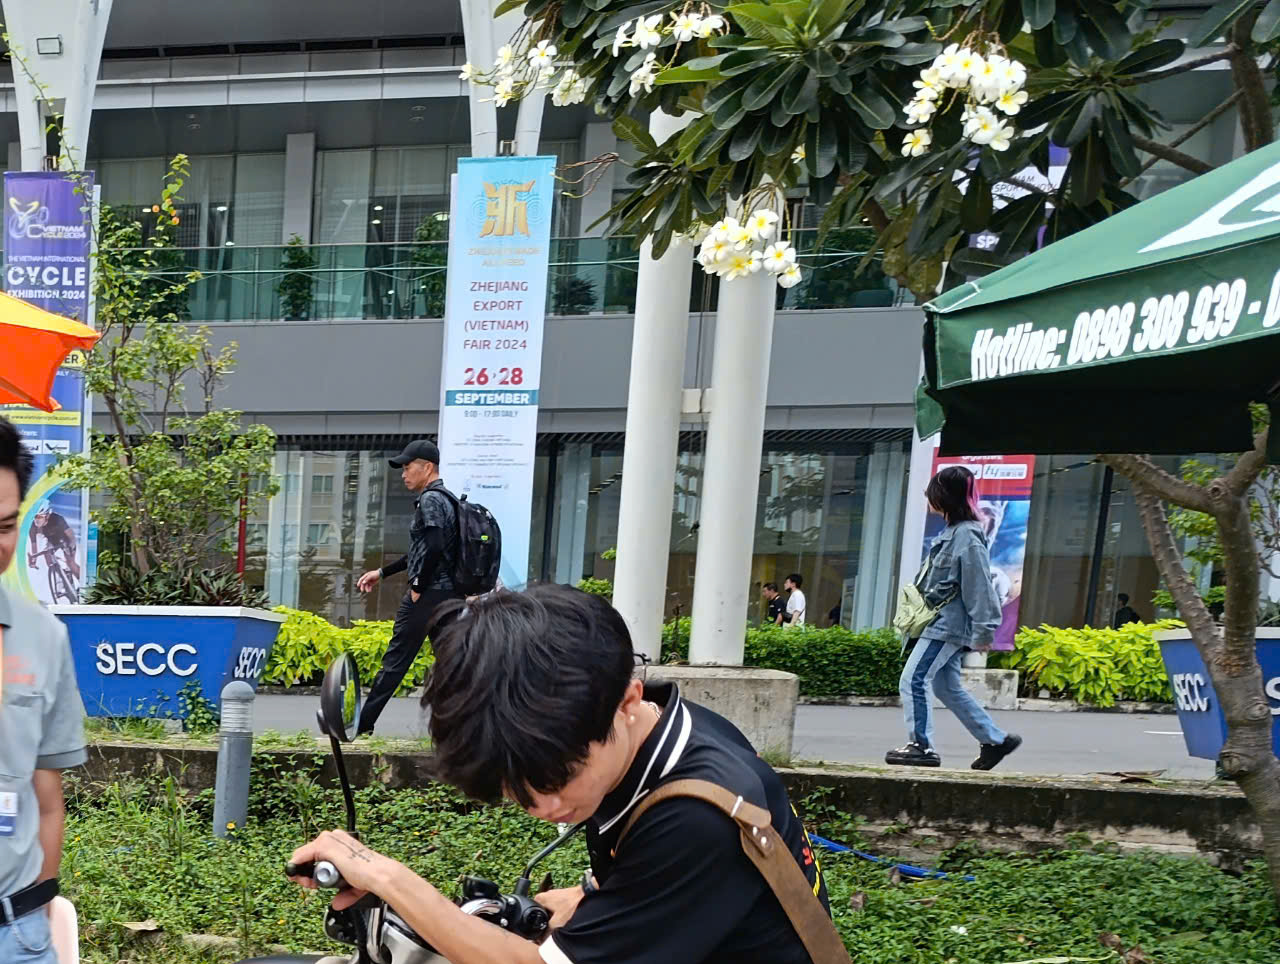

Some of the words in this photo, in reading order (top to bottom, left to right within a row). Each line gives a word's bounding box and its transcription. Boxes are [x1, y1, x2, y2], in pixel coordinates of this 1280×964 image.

[41, 225, 84, 233] VIETNAM
[7, 266, 86, 286] CYCLE
[470, 281, 528, 293] ZHEJIANG
[7, 290, 59, 299] EXHIBITION
[62, 290, 86, 299] 2024
[473, 300, 523, 311] EXPORT
[464, 320, 529, 332] (VIETNAM)
[971, 322, 1067, 381] Hotline:
[1066, 302, 1136, 365] 0898
[1133, 290, 1189, 352] 308
[1186, 278, 1247, 344] 939
[463, 339, 491, 350] FAIR
[495, 339, 528, 350] 2024
[464, 368, 489, 385] 26
[498, 368, 523, 385] 28
[455, 393, 530, 404] SEPTEMBER
[96, 642, 198, 676] SECC
[234, 646, 266, 679] SECC
[1173, 673, 1209, 712] SECC
